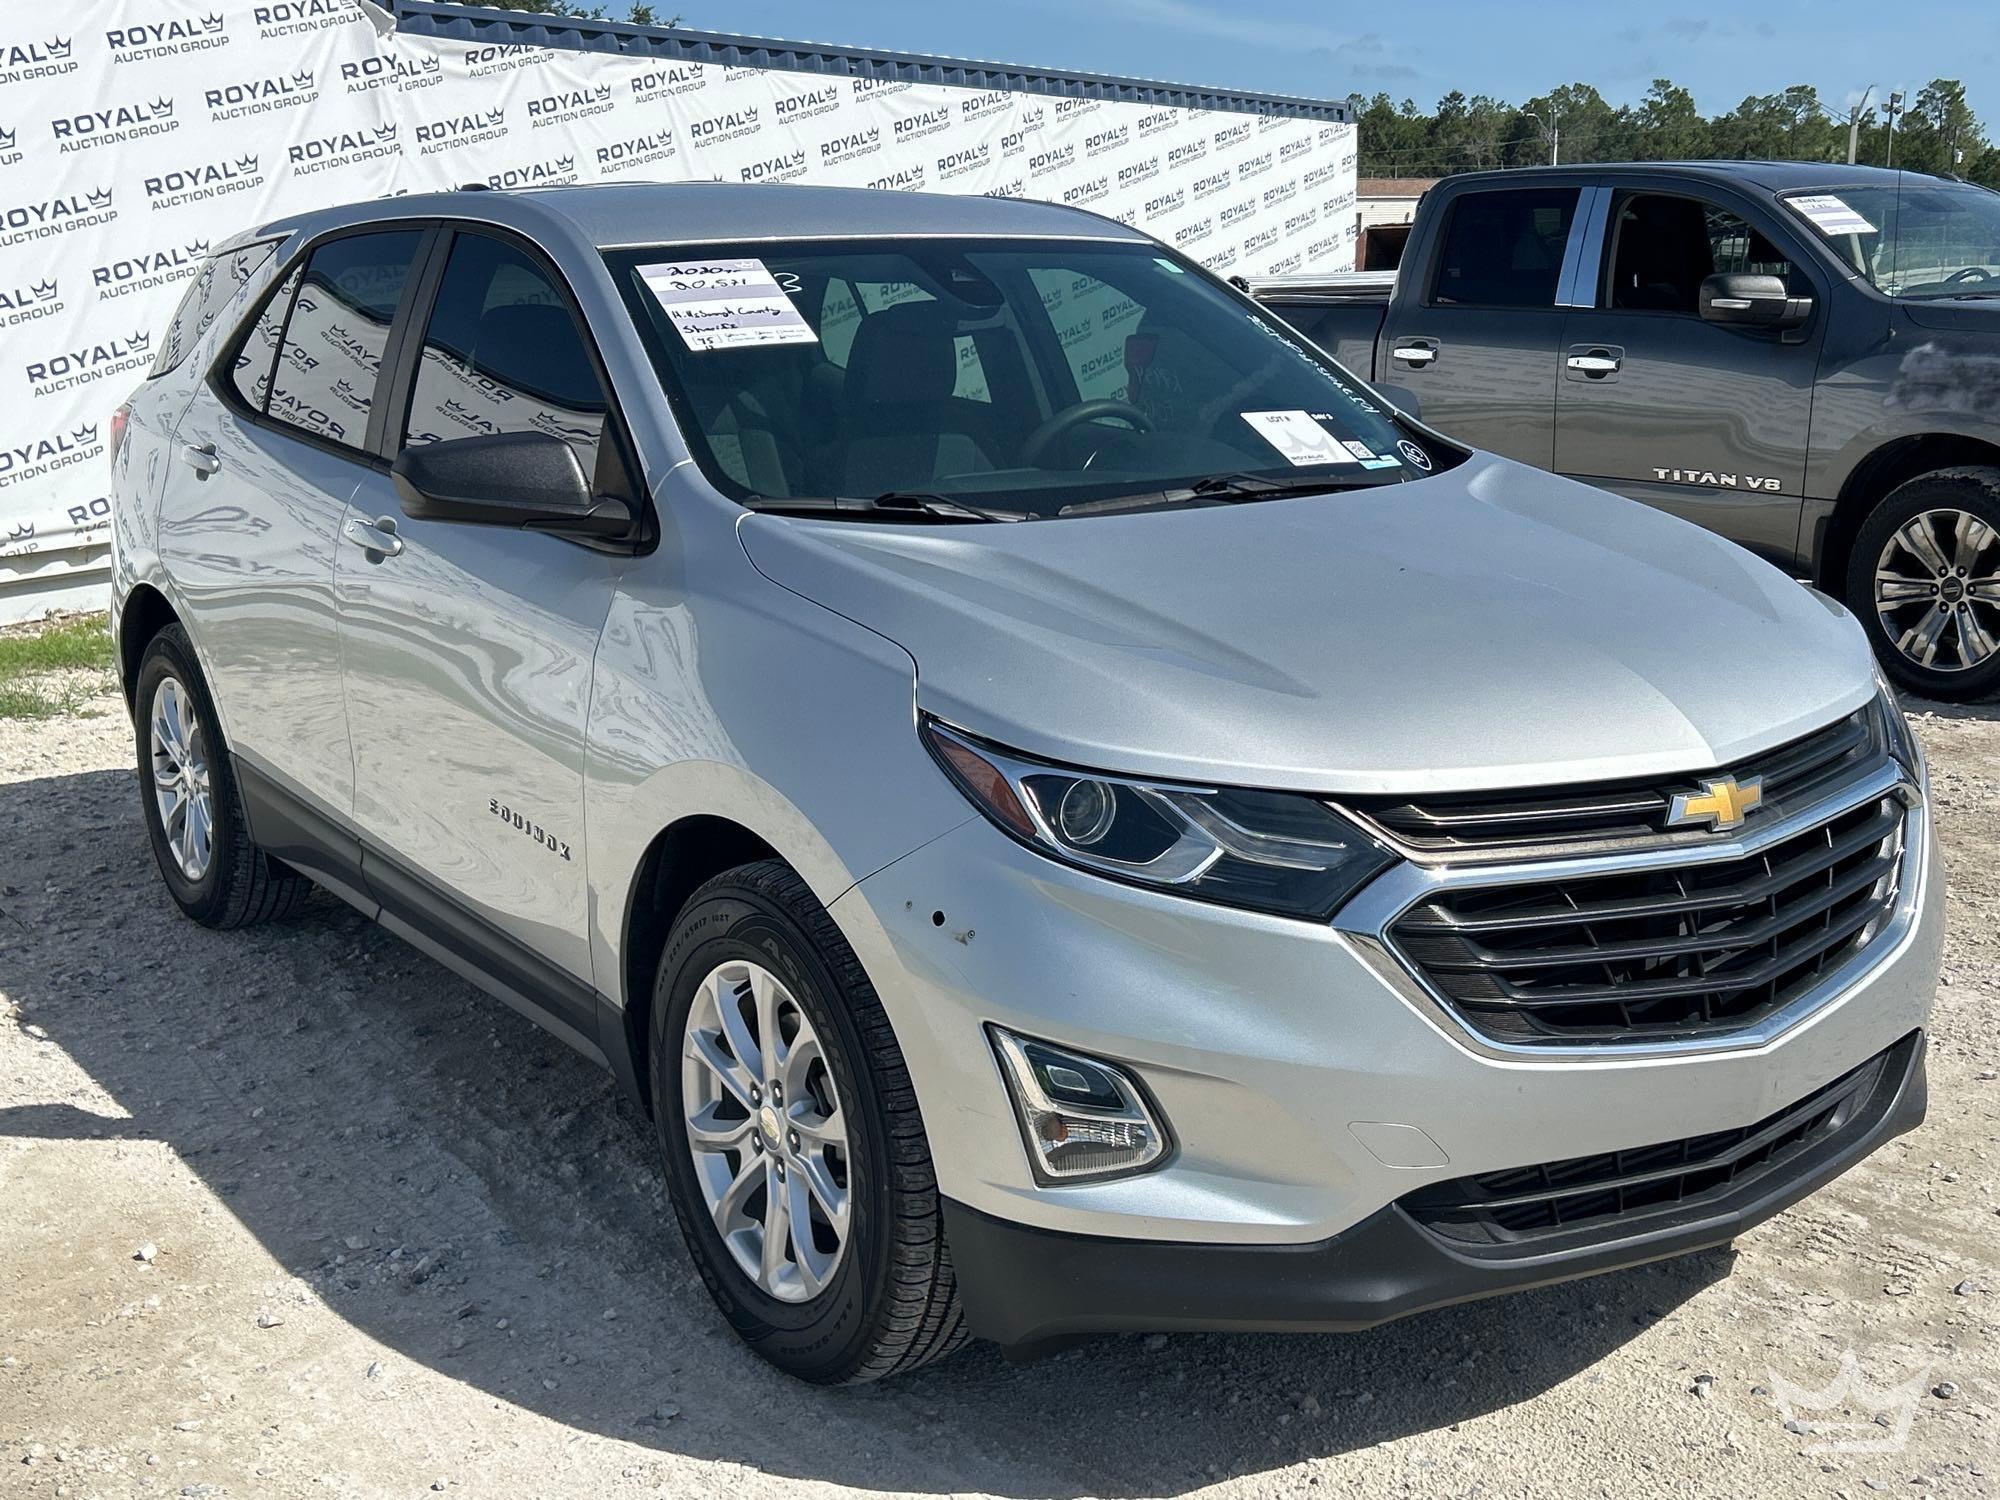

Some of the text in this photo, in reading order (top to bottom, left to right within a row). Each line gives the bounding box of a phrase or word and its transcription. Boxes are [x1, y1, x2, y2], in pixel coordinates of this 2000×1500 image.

[254, 0, 339, 25] ROYAL
[106, 19, 202, 49] ROYAL
[260, 21, 318, 40] AUCTION
[114, 36, 230, 64] AUCTION GROUP
[23, 61, 78, 80] GROUP
[469, 53, 555, 78] AUCTION GROUP
[405, 75, 443, 91] GROUP
[631, 67, 689, 93] ROYAL
[635, 80, 706, 104] AUCTION GROUP
[205, 77, 294, 108] ROYAL
[527, 89, 596, 117] ROYAL
[775, 90, 826, 115] ROYAL
[855, 89, 887, 104] AUCTION
[962, 91, 1002, 113] ROYAL
[212, 92, 319, 122] AUCTION GROUP
[532, 102, 615, 129] AUCTION GROUP
[778, 102, 840, 126] AUCTION GROUP
[52, 105, 151, 139] ROYAL
[416, 114, 488, 142] ROYAL
[690, 112, 746, 138] ROYAL
[893, 111, 938, 134] ROYAL
[896, 121, 951, 144] AUCTION GROUP
[1138, 111, 1170, 130] ROYAL
[1318, 123, 1345, 140] ROYAL
[60, 120, 179, 154] AUCTION GROUP
[288, 131, 375, 163] ROYAL
[421, 127, 509, 156] AUCTION GROUP
[694, 124, 761, 150] AUCTION GROUP
[820, 132, 868, 157] ROYAL
[1085, 128, 1120, 149] ROYAL
[1214, 126, 1243, 144] ROYAL
[1279, 137, 1306, 156] ROYAL
[294, 143, 401, 177] AUCTION GROUP
[596, 135, 659, 163] ROYAL
[823, 143, 881, 167] AUCTION GROUP
[937, 148, 979, 171] ROYAL
[1029, 148, 1066, 170] ROYAL
[1168, 142, 1198, 162] ROYAL
[600, 148, 676, 175] AUCTION GROUP
[740, 155, 793, 183] ROYAL
[1118, 160, 1150, 181] ROYAL
[1238, 154, 1265, 174] ROYAL
[144, 162, 238, 197] ROYAL
[488, 162, 557, 190] ROYAL
[780, 166, 808, 182] GROUP
[1193, 173, 1222, 193] ROYAL
[1303, 166, 1328, 184] ROYAL
[152, 176, 264, 211] AUCTION GROUP
[1063, 180, 1100, 202] ROYAL
[1145, 192, 1177, 213] ROYAL
[1263, 183, 1289, 202] ROYAL
[1323, 193, 1348, 212] ROYAL
[1220, 202, 1249, 221] ROYAL
[1285, 211, 1310, 230] ROYAL
[0, 210, 118, 247] UCTION GROUP
[1175, 221, 1204, 242] ROYAL
[1244, 230, 1270, 250] ROYAL
[1307, 236, 1333, 256] ROYAL
[92, 248, 188, 287] ROYAL
[1269, 257, 1294, 276] ROYAL
[99, 275, 164, 301] AUCTION
[8, 302, 64, 325] GROUP
[26, 341, 128, 383] ROYAL
[34, 353, 156, 398] AUCTION GROUP
[50, 445, 104, 470] GROUP
[1653, 467, 1781, 491] TITAN V8
[489, 798, 571, 861] EQUINOX
